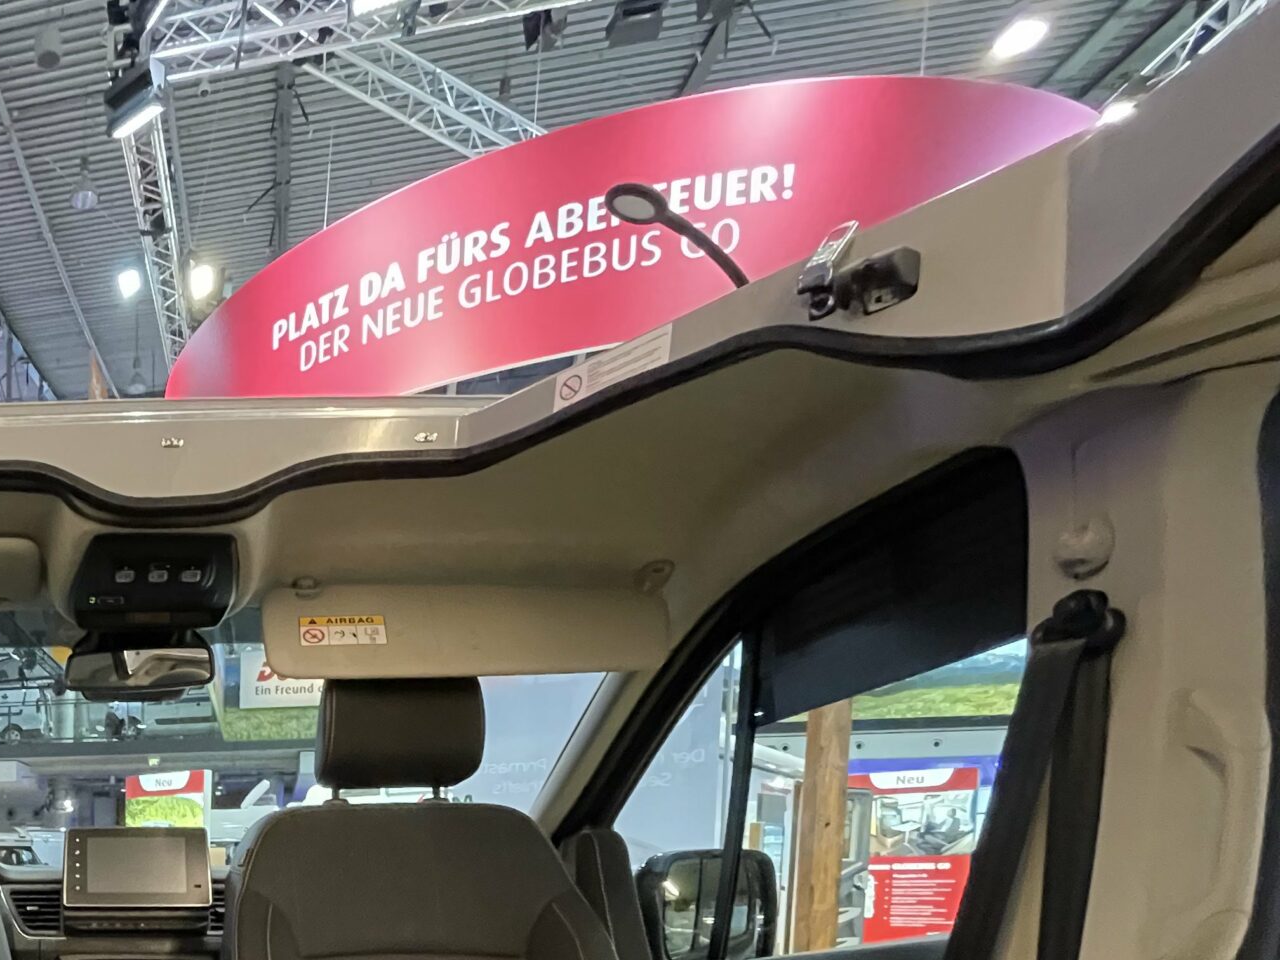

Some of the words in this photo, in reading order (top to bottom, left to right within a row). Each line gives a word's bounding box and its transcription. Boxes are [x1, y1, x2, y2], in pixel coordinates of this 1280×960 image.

[272, 283, 350, 351] PLATZ
[359, 262, 406, 306] DA
[417, 222, 510, 284] FÜRS
[524, 163, 795, 248] ABEEUER!
[300, 324, 350, 372] DER
[362, 285, 444, 345] NEUE
[458, 230, 661, 308] GLOBEBUS
[255, 684, 271, 696] Ein
[275, 683, 314, 695] Freund
[155, 778, 172, 787] Neu
[896, 775, 924, 785] Neu
